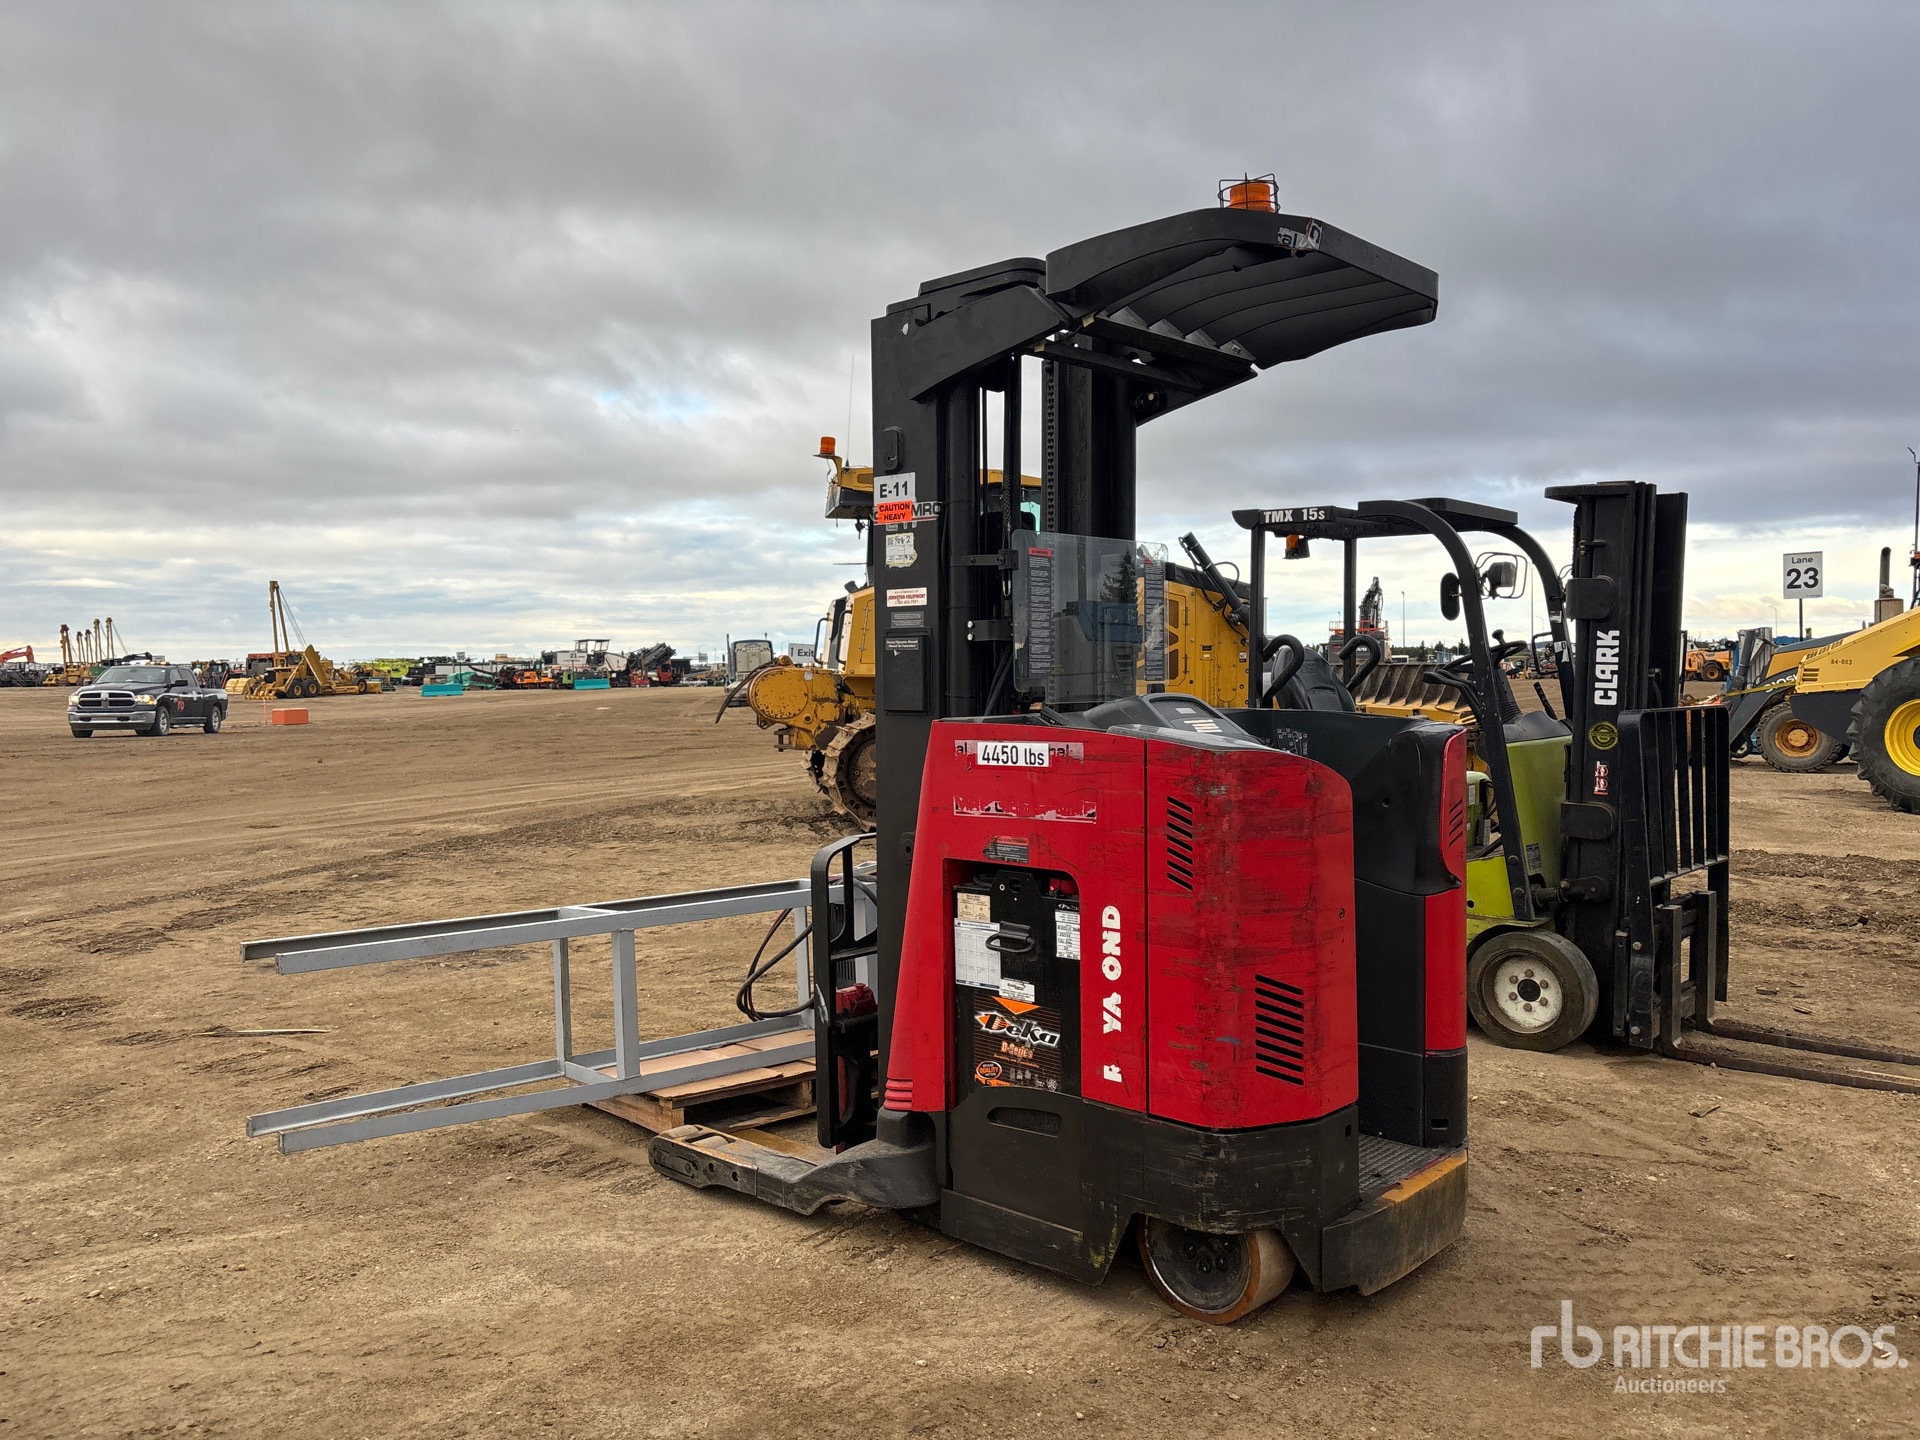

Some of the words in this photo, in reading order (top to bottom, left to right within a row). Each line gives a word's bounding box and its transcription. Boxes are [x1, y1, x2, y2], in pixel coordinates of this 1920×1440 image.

[880, 481, 908, 498] E-11
[879, 502, 911, 512] CAUTION
[1263, 509, 1293, 523] TMX
[1302, 508, 1325, 520] 15s
[883, 513, 906, 521] HEAVY
[1786, 567, 1819, 589] 23
[797, 649, 814, 657] Exit
[1594, 630, 1620, 706] CLARK
[982, 745, 1019, 764] 4450
[1024, 747, 1045, 765] lbs
[975, 1012, 1060, 1046] Deka
